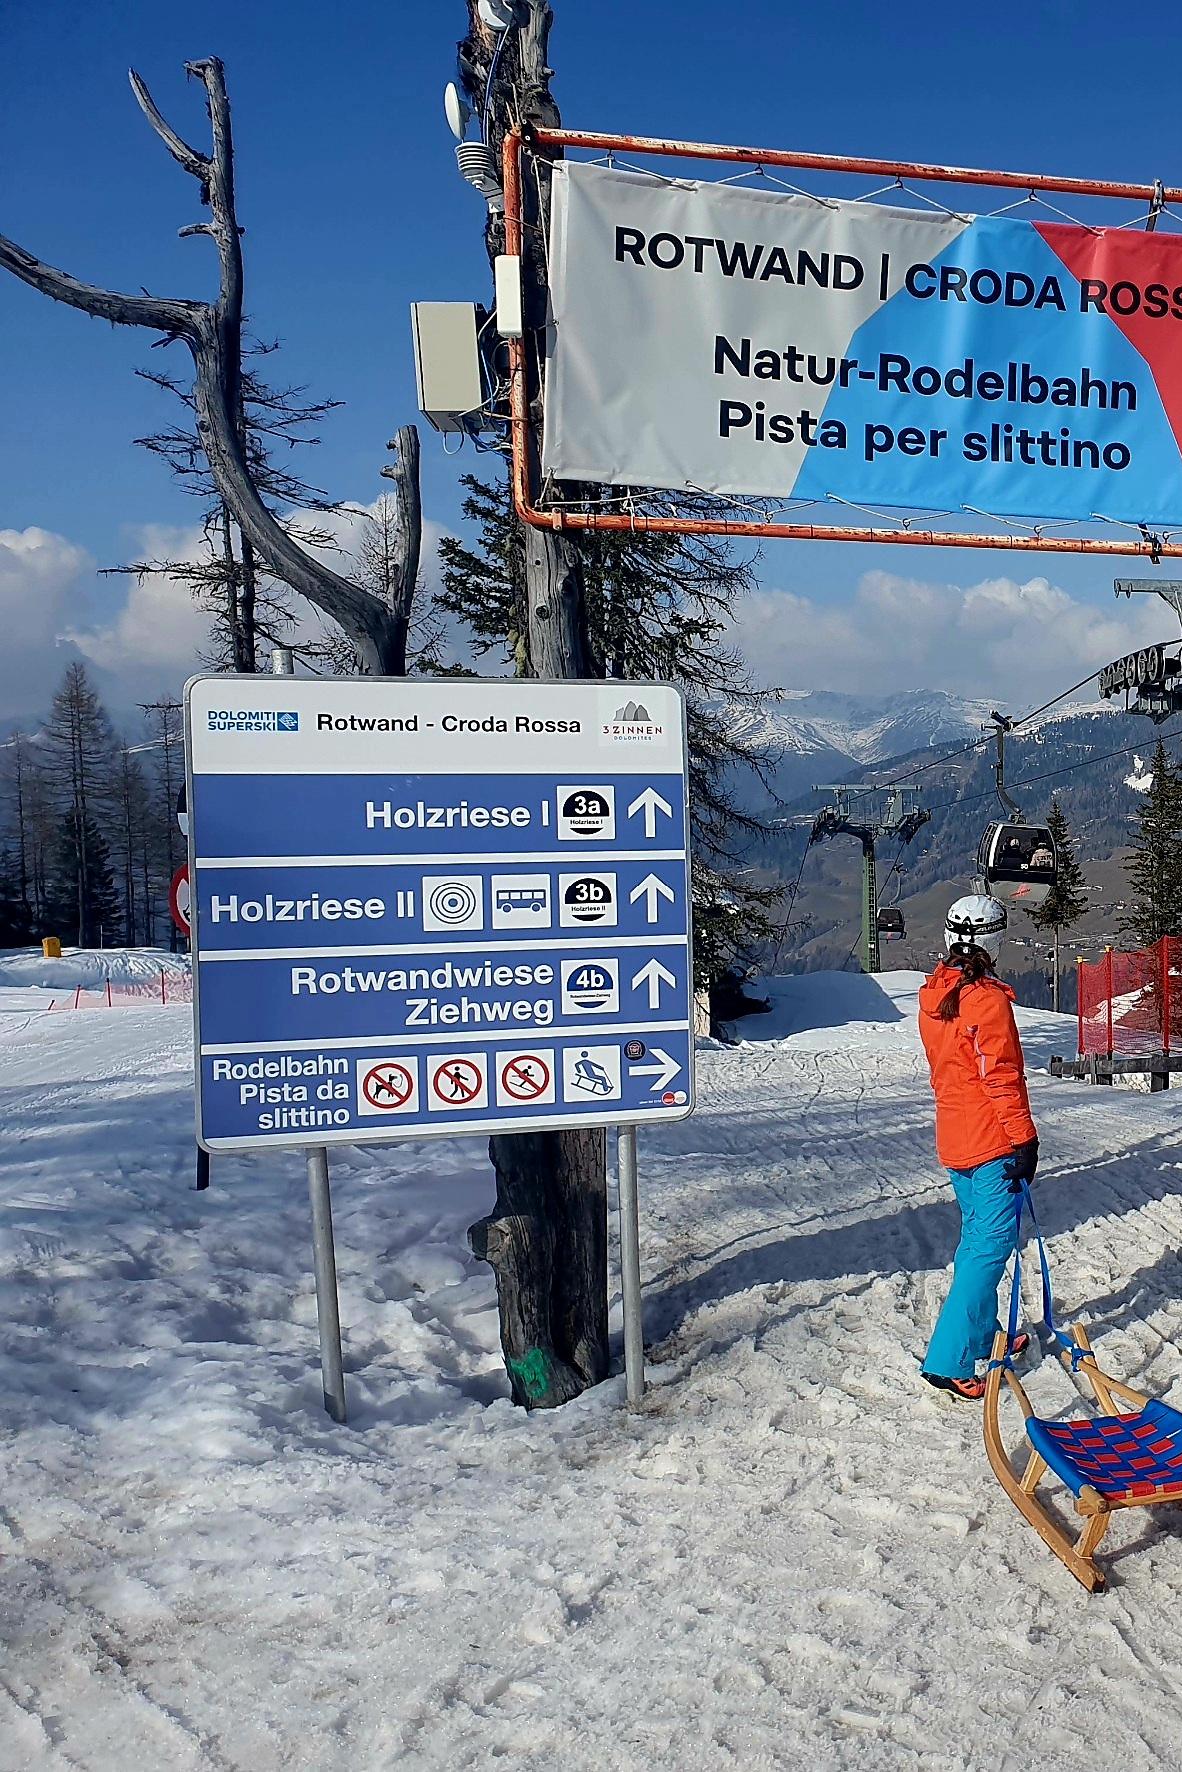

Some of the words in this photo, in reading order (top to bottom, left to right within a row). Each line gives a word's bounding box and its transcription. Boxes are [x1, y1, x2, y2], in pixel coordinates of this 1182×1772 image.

[615, 225, 865, 291] ROTWAND
[904, 263, 1067, 312] CRODA
[714, 334, 1137, 411] Natur-Rodelbahn
[719, 399, 848, 449] Pista
[864, 421, 948, 462] per
[962, 422, 1131, 471] slittino
[208, 710, 276, 721] DOLOMITI
[208, 721, 276, 732] SUPERSKI
[317, 713, 418, 732] Rotwand
[441, 714, 508, 733] Croda
[515, 715, 581, 734] Rossa
[612, 725, 663, 735] ZINNEN
[366, 801, 531, 828] Holzriese
[541, 800, 549, 827] I
[574, 796, 601, 814] 3a
[575, 883, 604, 901] 3b
[210, 893, 386, 923] Holzriese
[396, 890, 415, 918] II
[291, 961, 554, 995] Rotwandwiese
[576, 969, 605, 988] 4b
[405, 996, 554, 1026] Ziehweg
[213, 1054, 349, 1081] Rodelbahn
[240, 1082, 308, 1105] Pista
[316, 1079, 349, 1101] da
[258, 1106, 350, 1130] slittino
